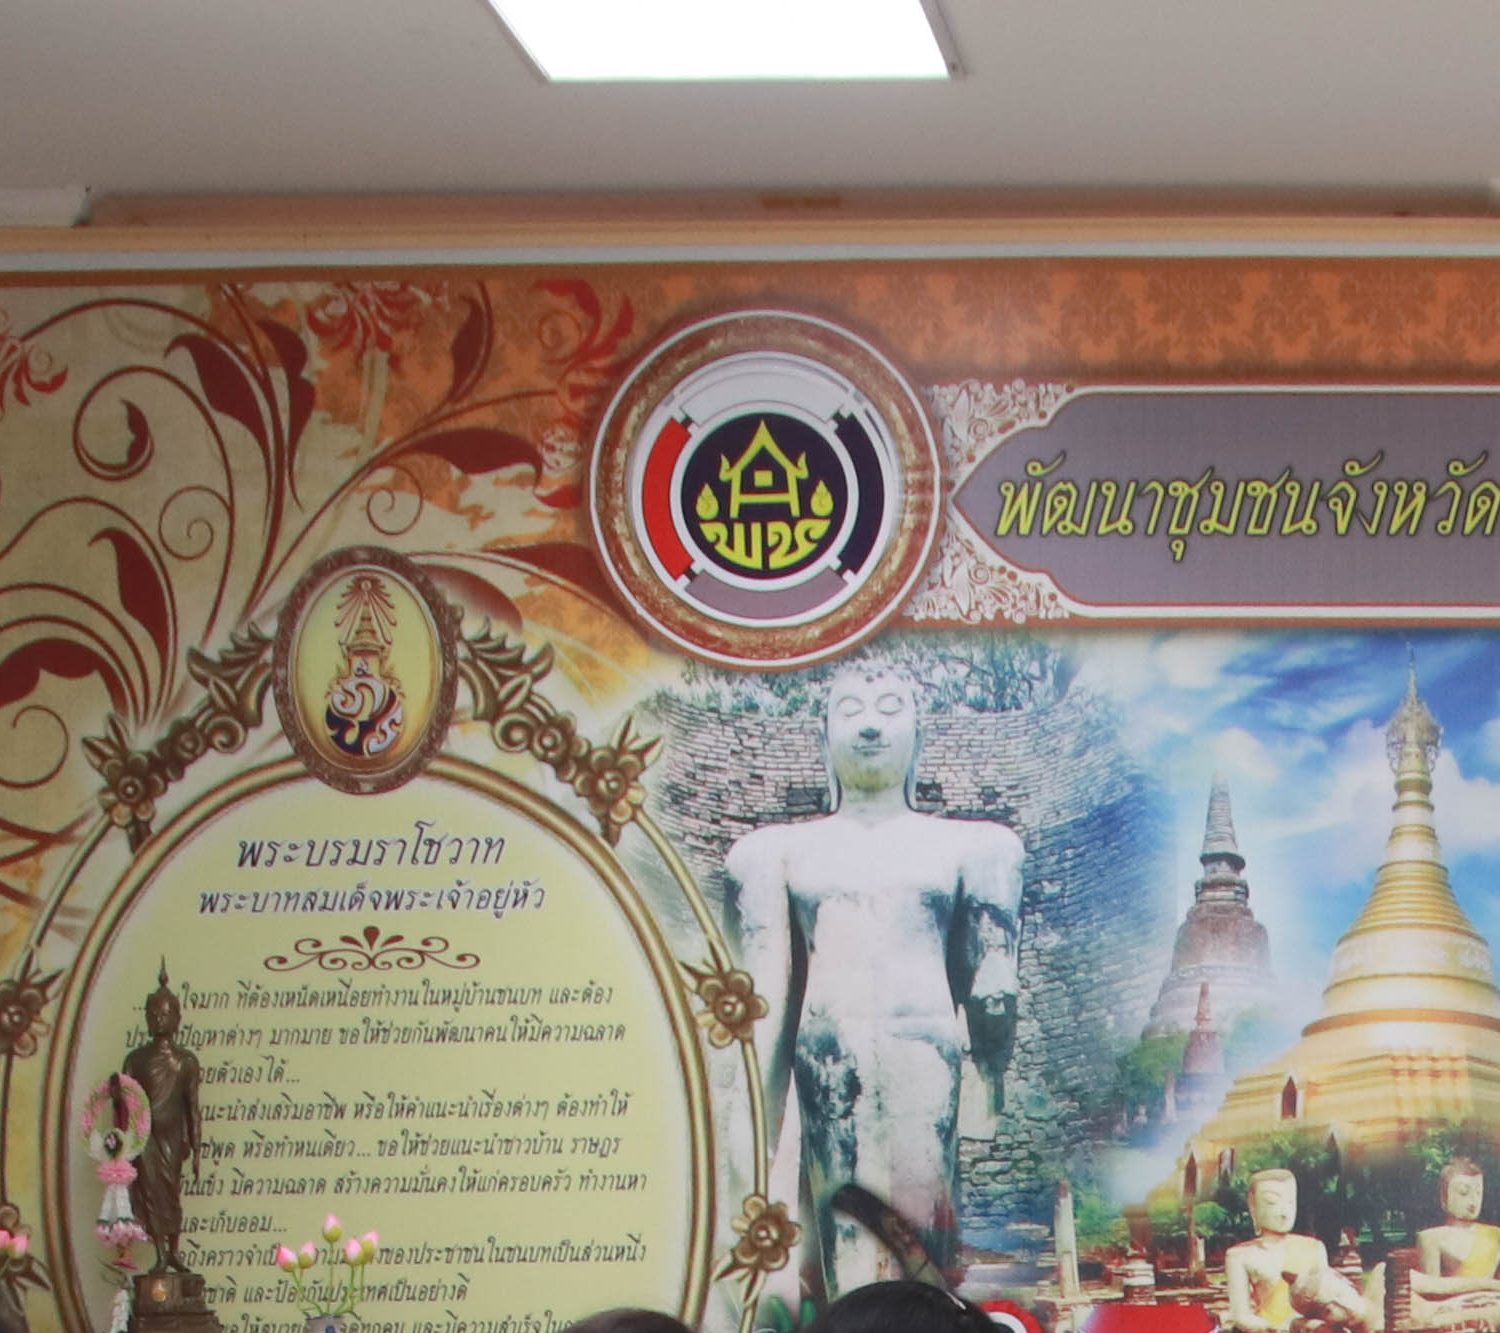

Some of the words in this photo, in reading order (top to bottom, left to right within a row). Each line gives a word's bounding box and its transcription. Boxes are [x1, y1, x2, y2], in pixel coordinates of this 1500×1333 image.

[237, 818, 506, 870] พระบรมราโชวาท
[199, 876, 546, 919] พระบาทสมเด็จพระเจ้าอยู่หัว
